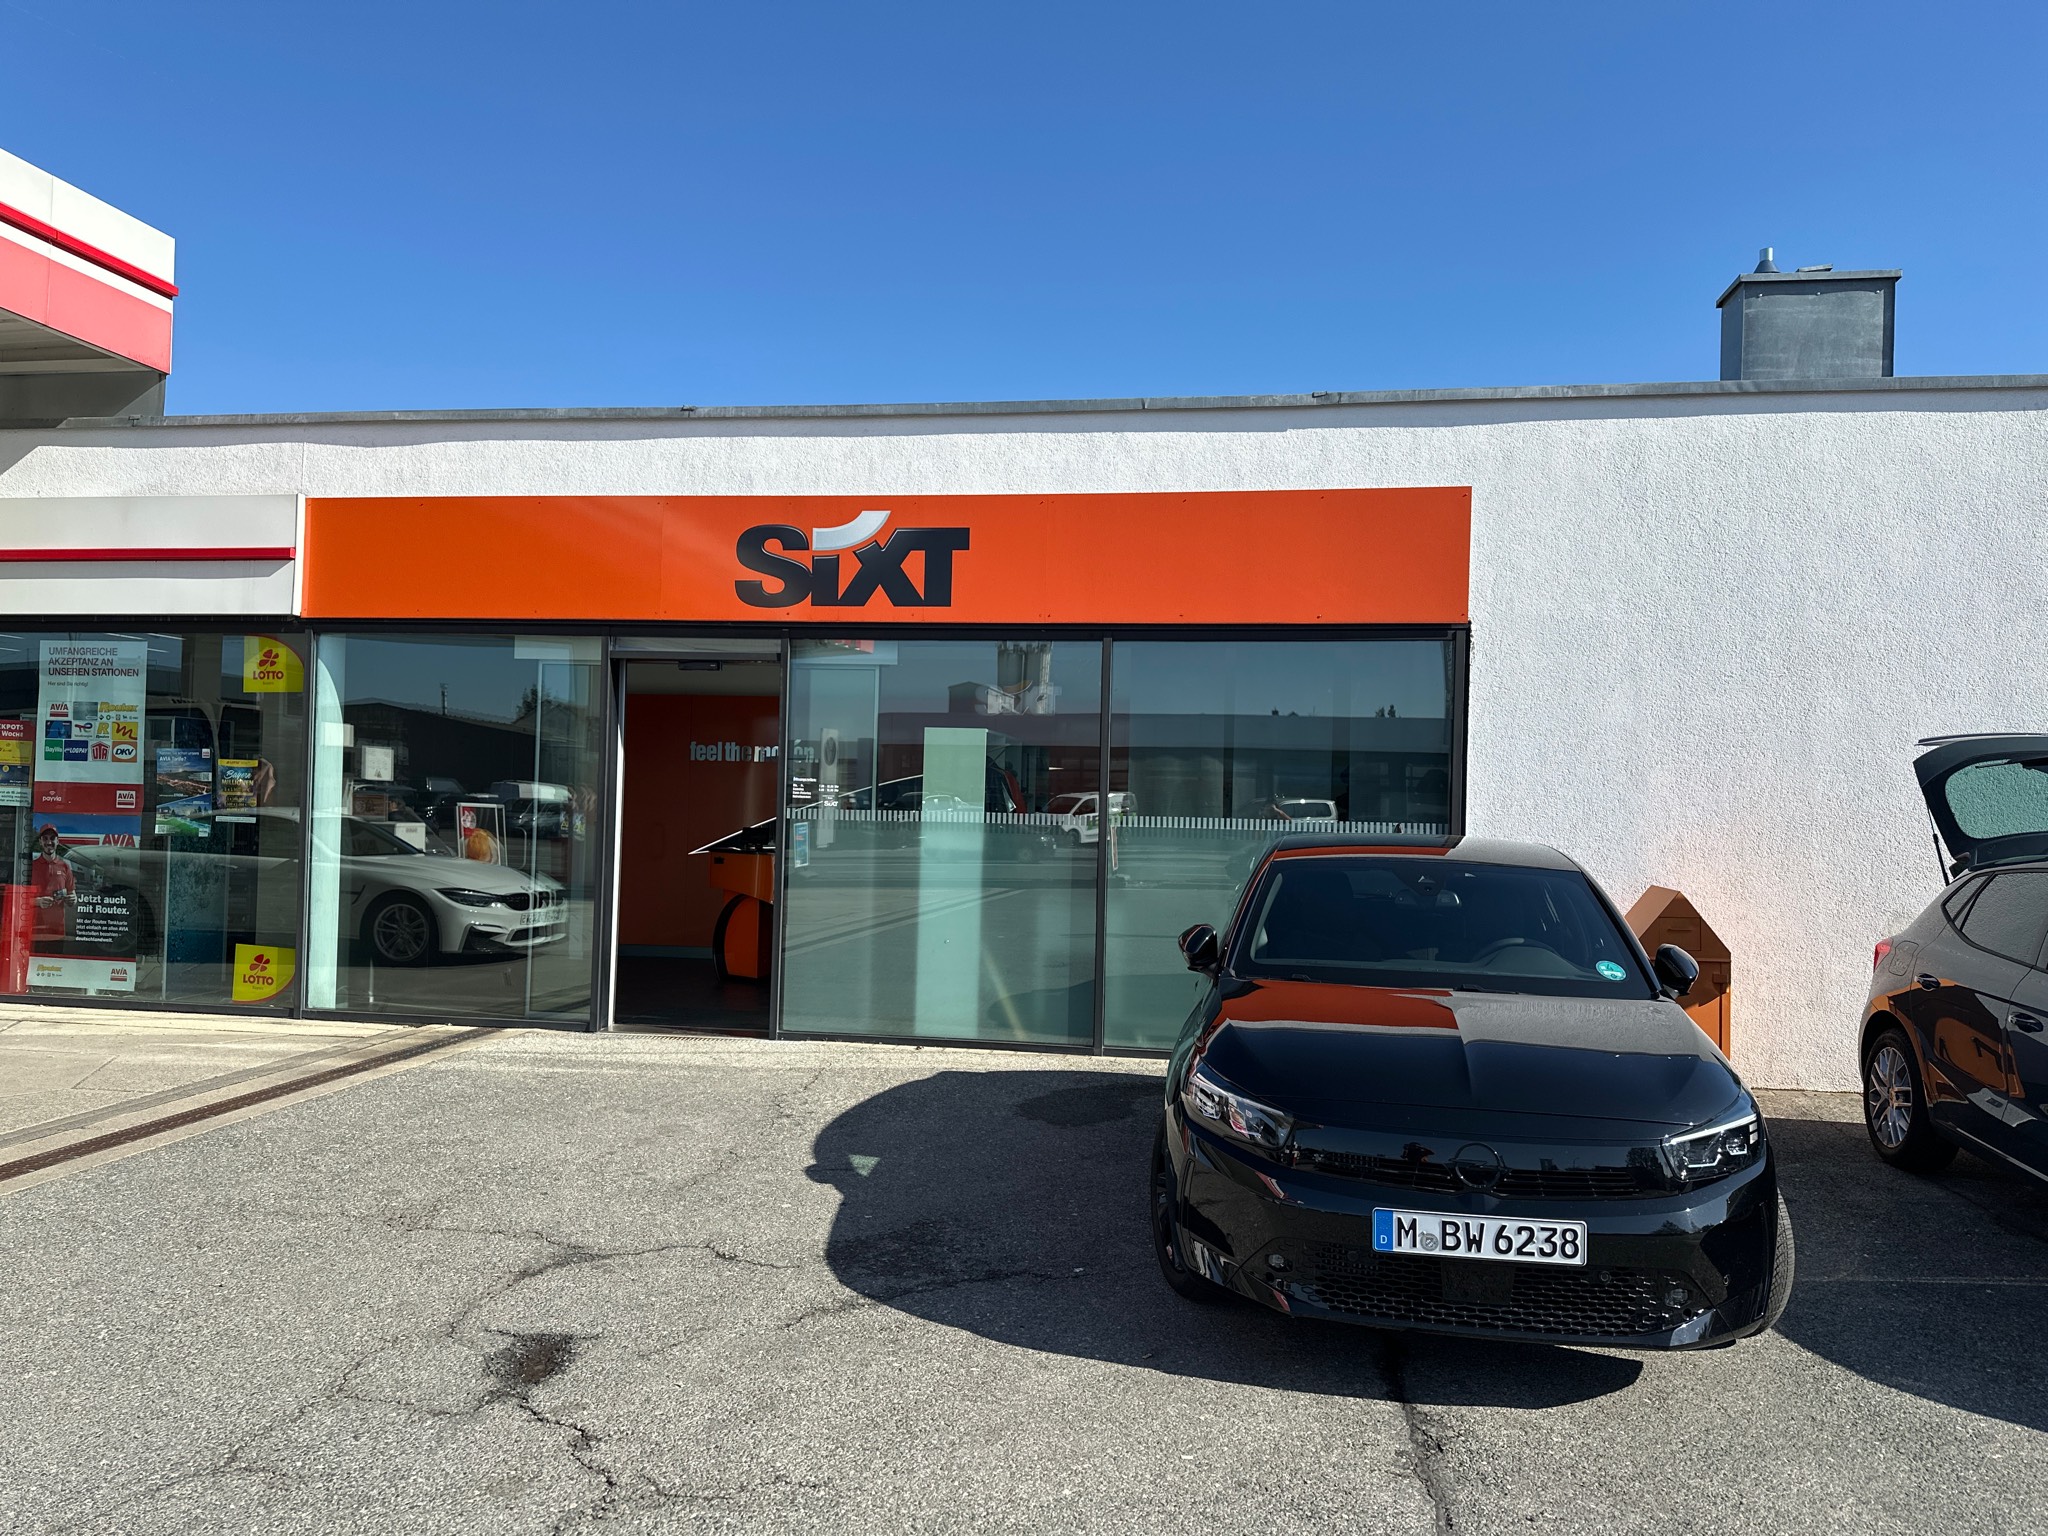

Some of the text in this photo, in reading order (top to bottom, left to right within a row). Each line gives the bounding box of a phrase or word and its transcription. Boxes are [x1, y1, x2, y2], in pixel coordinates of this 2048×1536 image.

[48, 647, 118, 656] UMFANGREICHE
[48, 657, 113, 666] AKZEPTANZ AN
[48, 667, 139, 677] UNSEREN STATIONEN
[252, 670, 284, 680] LOTTO
[50, 702, 69, 711] AVIA
[98, 701, 139, 713] Routex
[114, 748, 135, 756] DKV
[690, 741, 722, 761] feel
[725, 741, 752, 762] the
[224, 769, 253, 780] Bayern
[117, 791, 135, 800] AVIA
[102, 832, 136, 848] AVIA
[78, 894, 126, 905] Jetzt auch
[77, 905, 130, 915] mit Routex.
[110, 967, 128, 976] AVIA
[242, 973, 275, 986] LOTTO
[1379, 1234, 1388, 1244] D
[1396, 1215, 1580, 1259] M BW 6238
